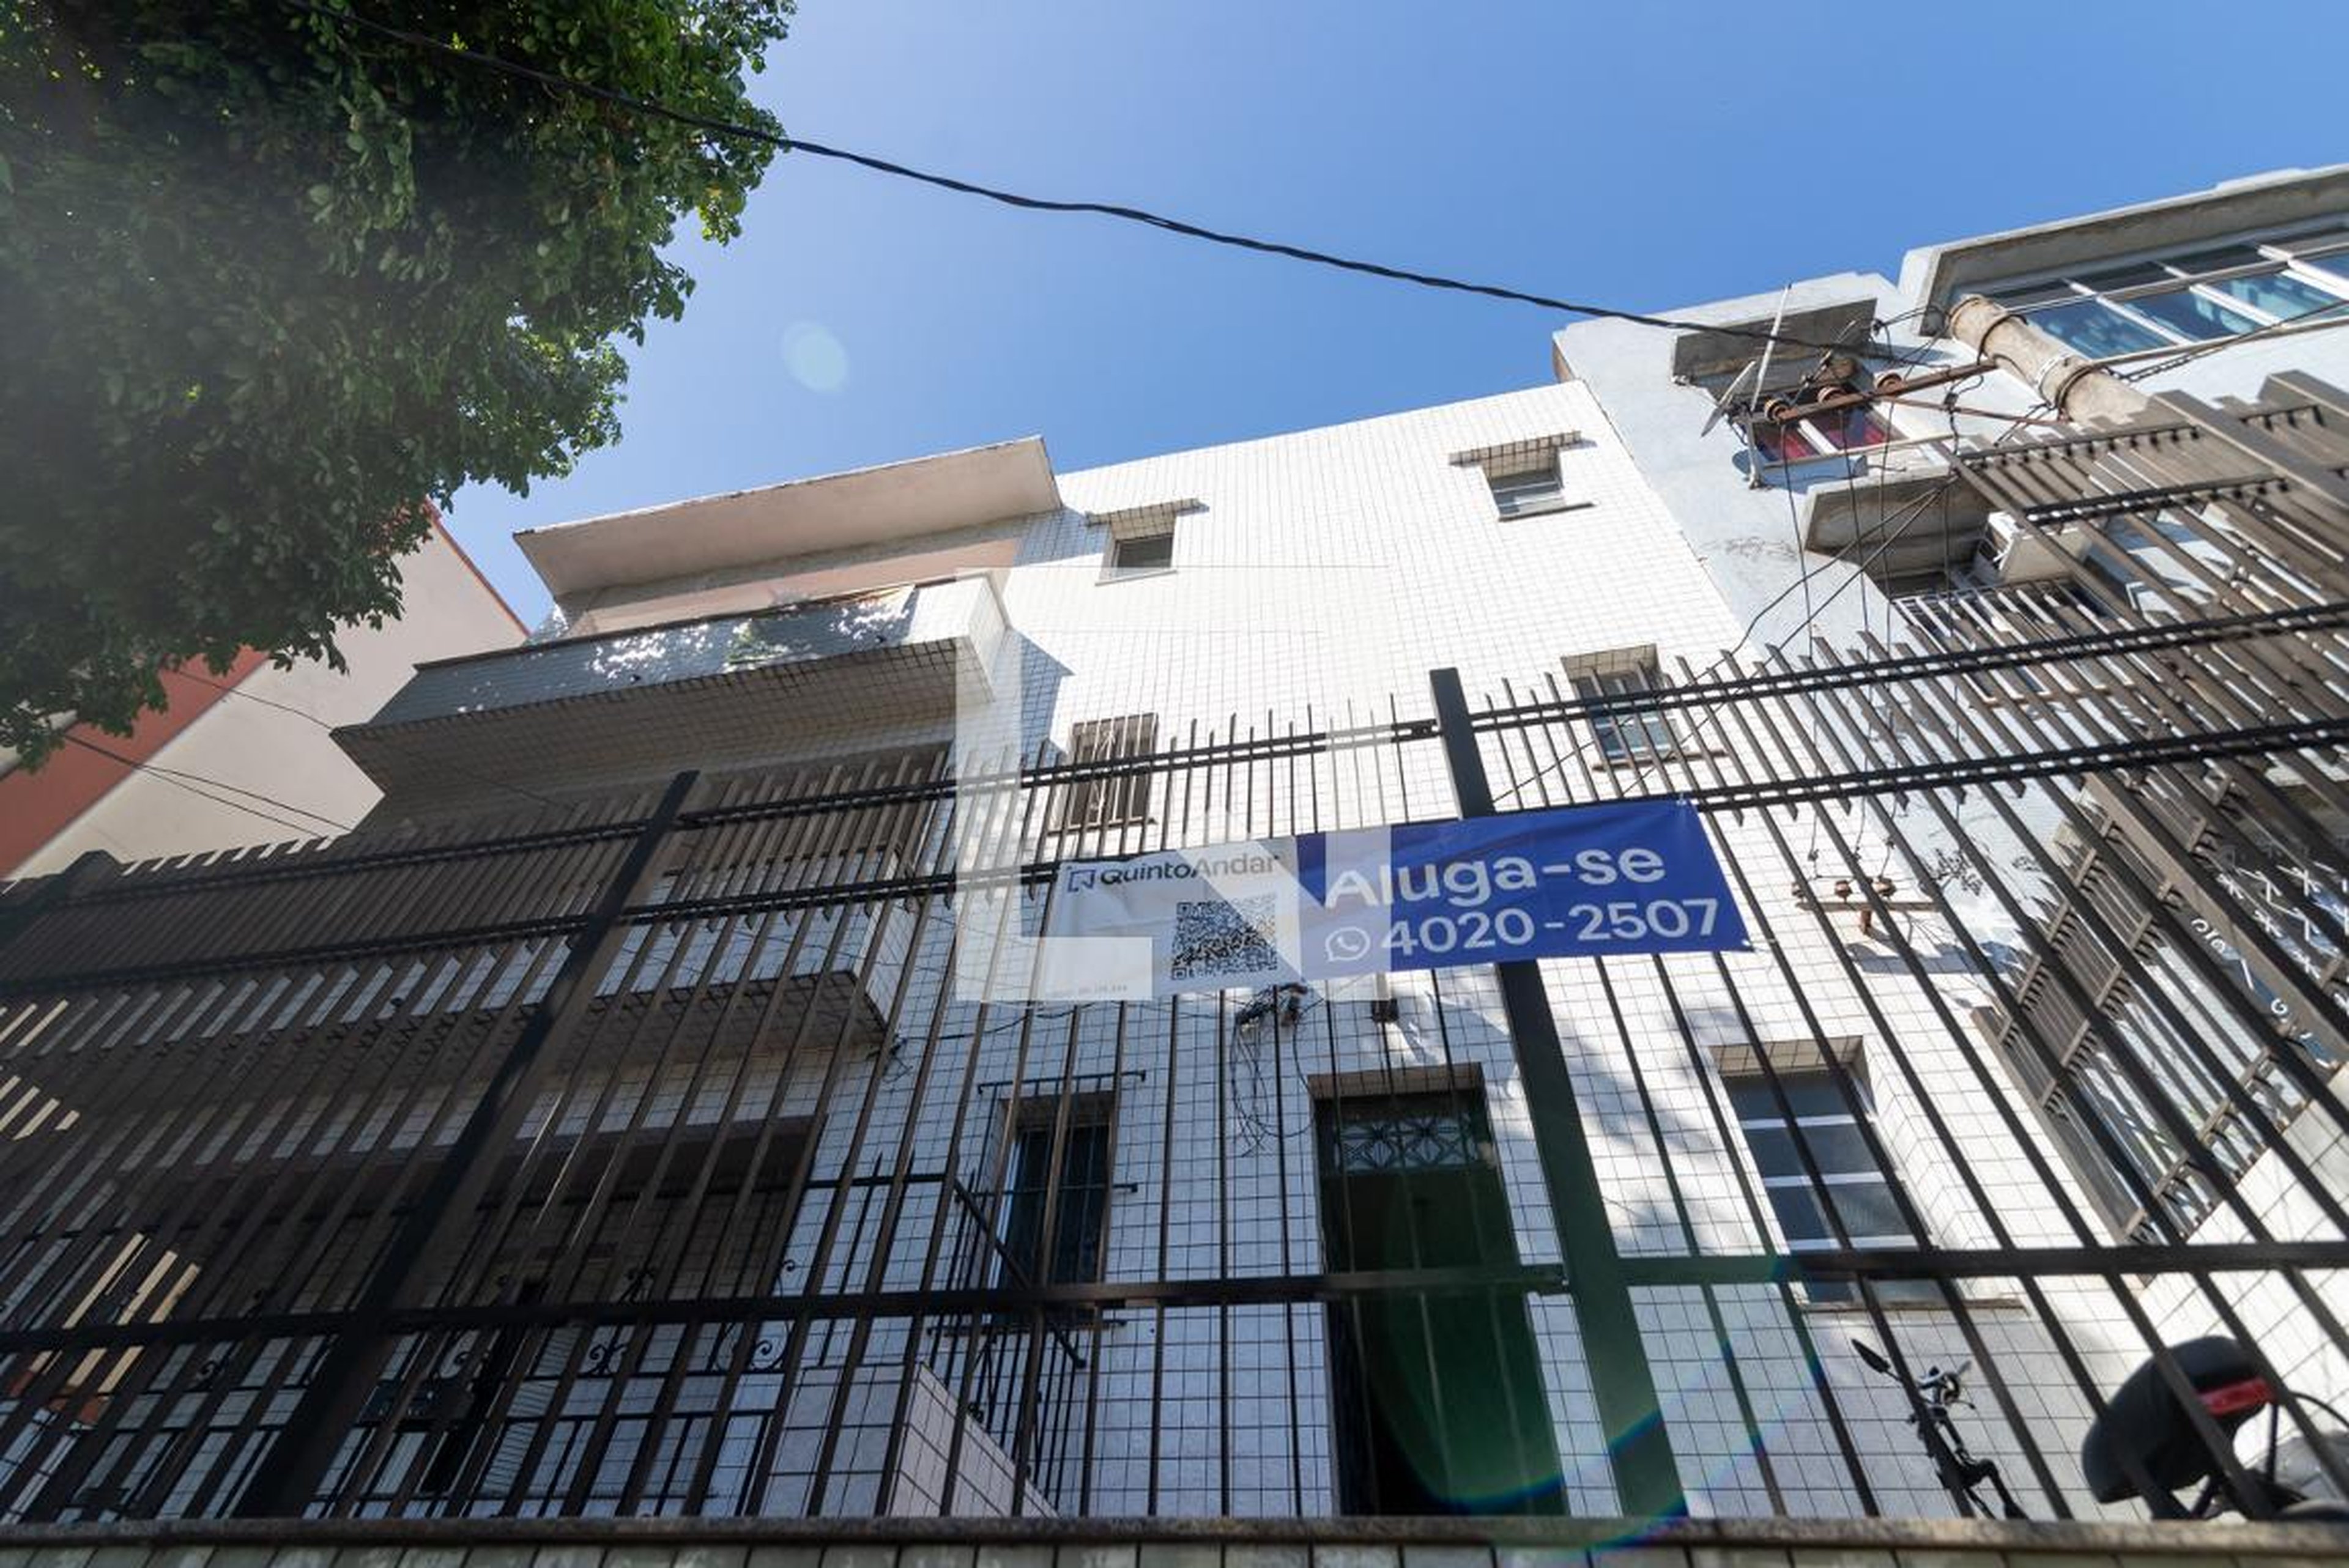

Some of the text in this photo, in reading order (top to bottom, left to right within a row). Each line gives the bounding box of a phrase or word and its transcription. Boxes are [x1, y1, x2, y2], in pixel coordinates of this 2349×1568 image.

[1100, 852, 1278, 886] QuintoAndar
[1325, 848, 1666, 909] Aluga-se
[1380, 897, 1718, 955] 4020-2507
